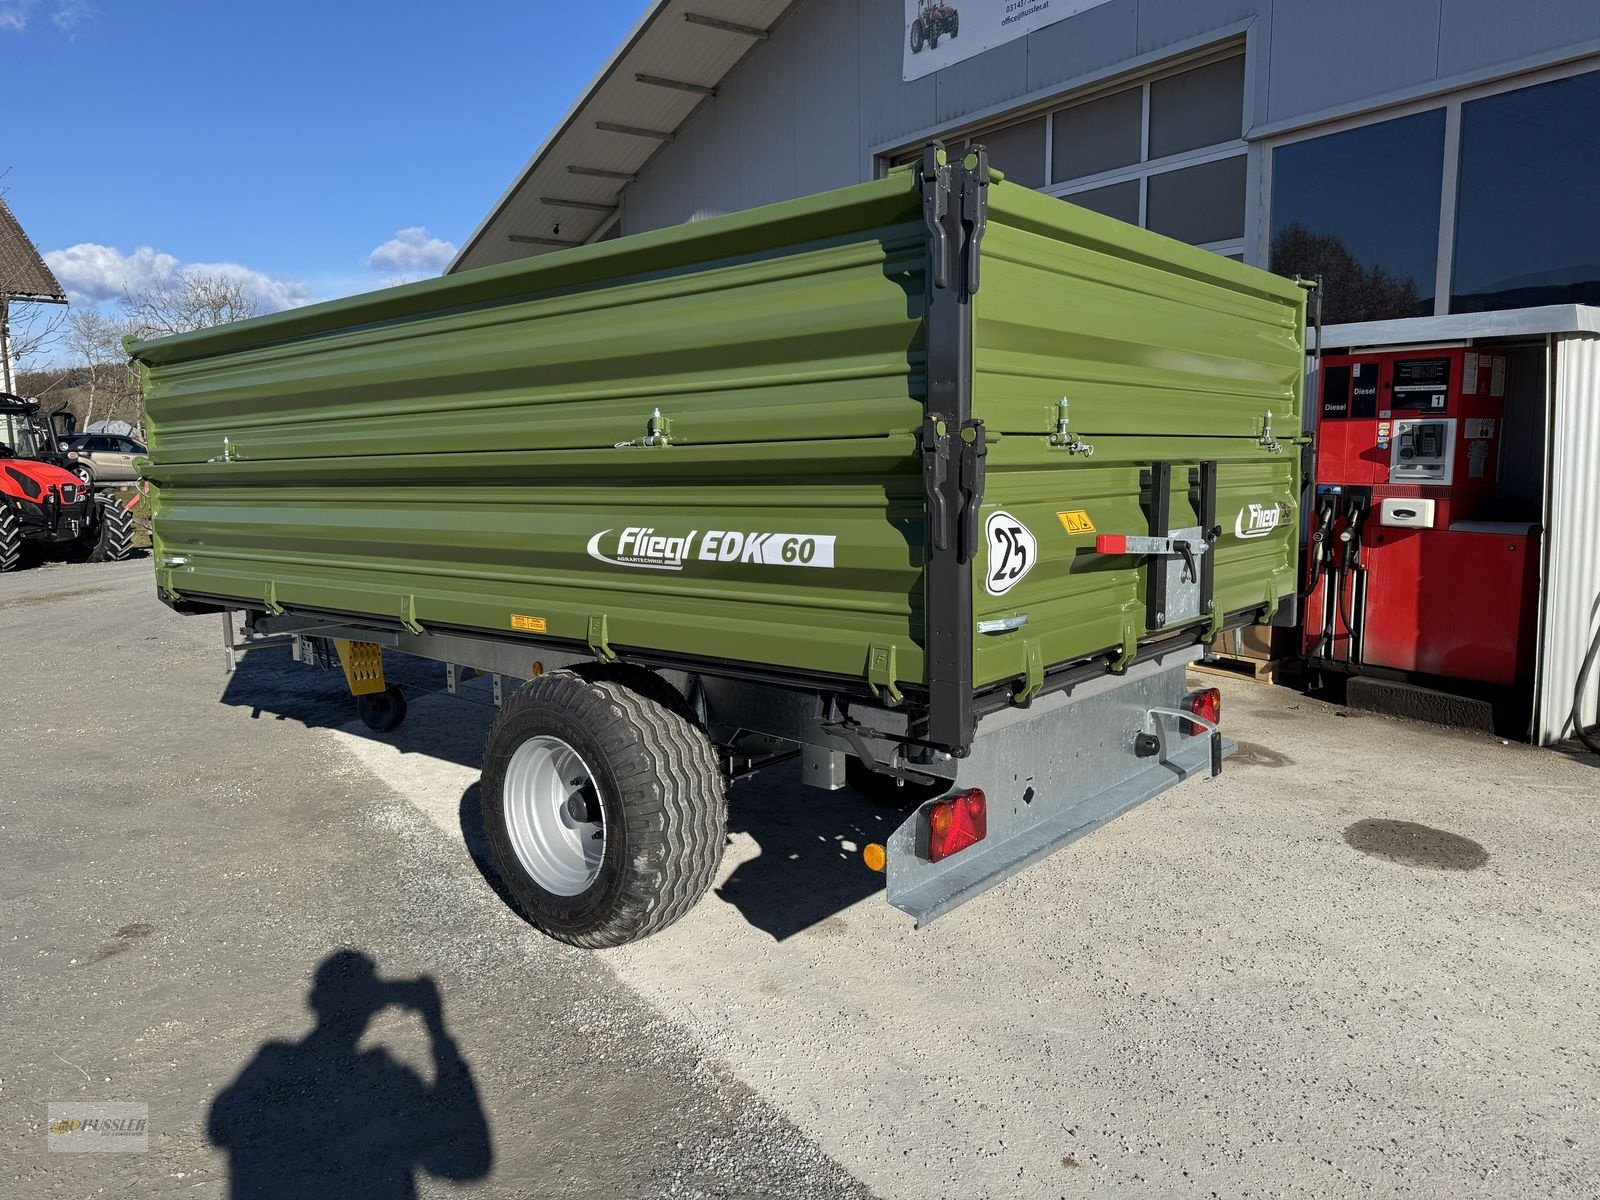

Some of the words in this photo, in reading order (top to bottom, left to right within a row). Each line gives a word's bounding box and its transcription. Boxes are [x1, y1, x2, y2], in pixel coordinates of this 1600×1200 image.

[1001, 0, 1049, 26] office@hussler.at
[1353, 387, 1376, 395] Diesel
[1324, 403, 1347, 411] Diesel
[1245, 502, 1280, 534] Fliegl
[616, 526, 698, 565] Fliegl
[698, 530, 772, 564] EDK
[780, 537, 816, 564] 60
[992, 527, 1027, 581] 25
[616, 556, 665, 565] AGRARTECHNIK
